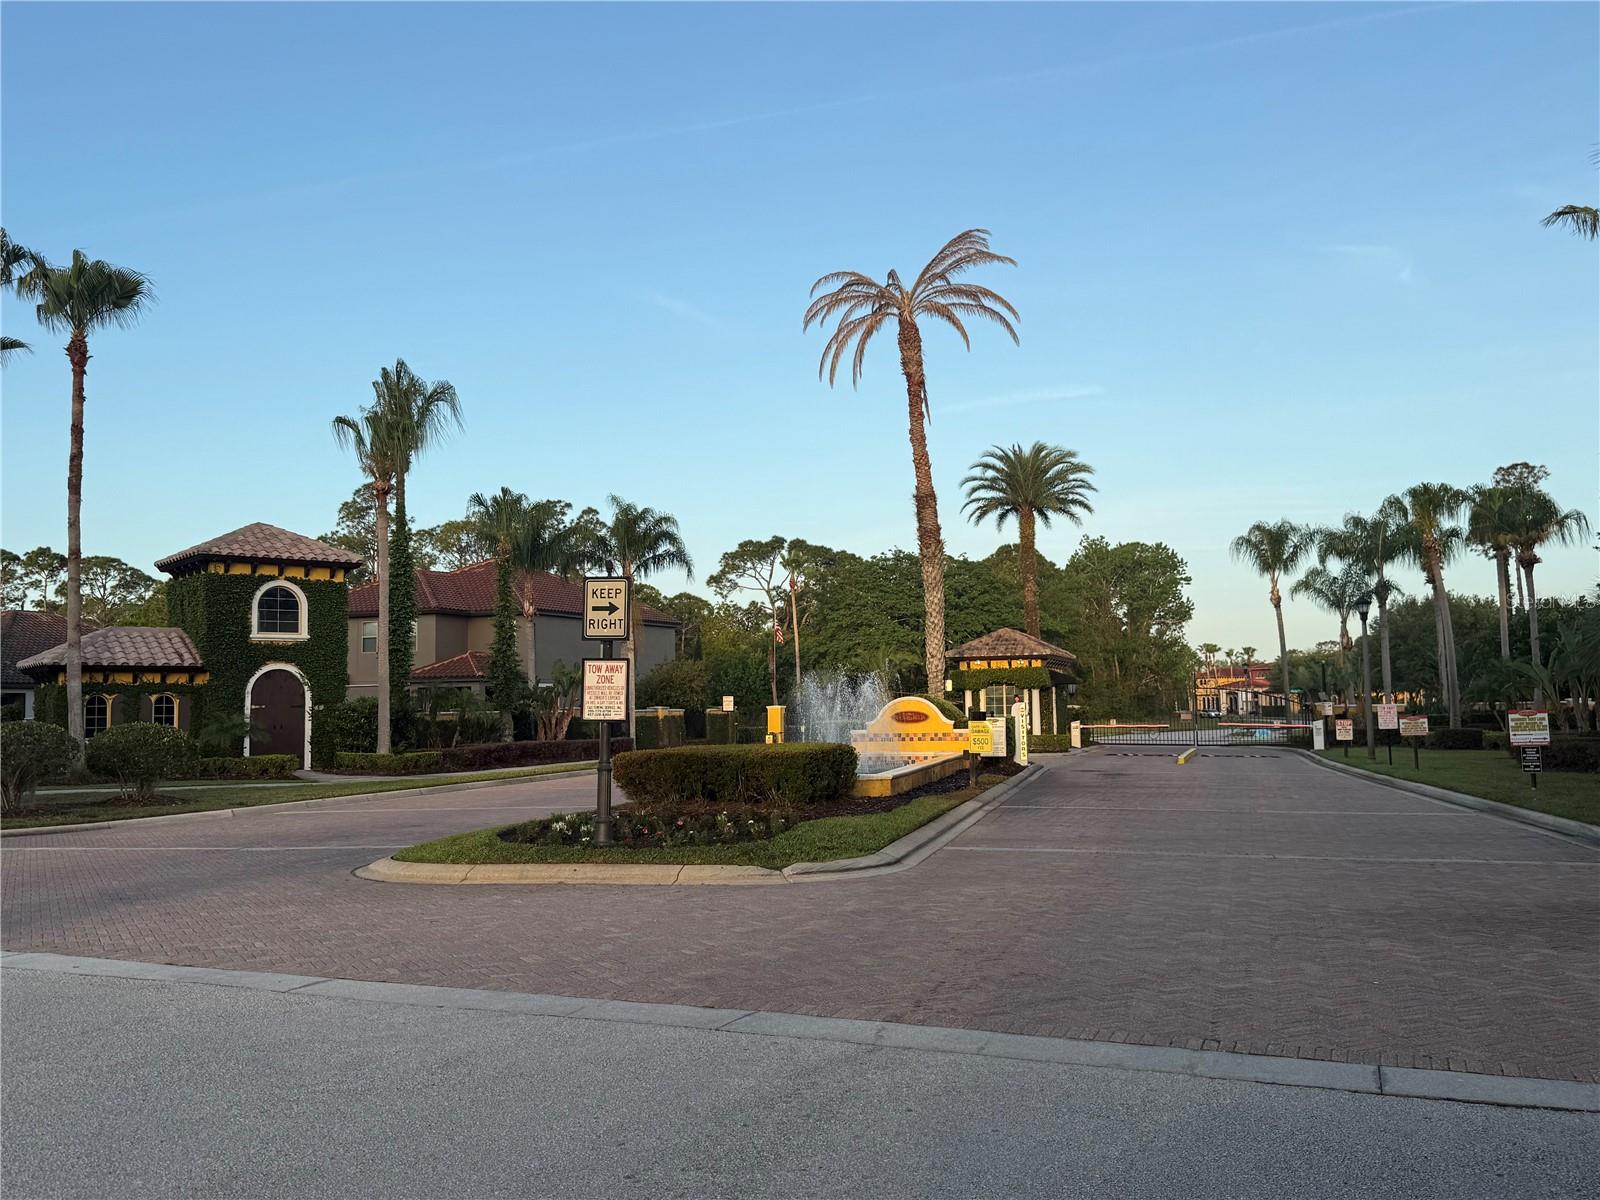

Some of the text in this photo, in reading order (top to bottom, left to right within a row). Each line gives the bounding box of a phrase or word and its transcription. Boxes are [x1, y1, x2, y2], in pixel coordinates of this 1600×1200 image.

[592, 588, 622, 599] KEEP
[588, 618, 624, 630] RIGHT
[588, 664, 624, 674] TOW AWAY
[596, 675, 615, 684] ZONE
[972, 737, 989, 745] $500
